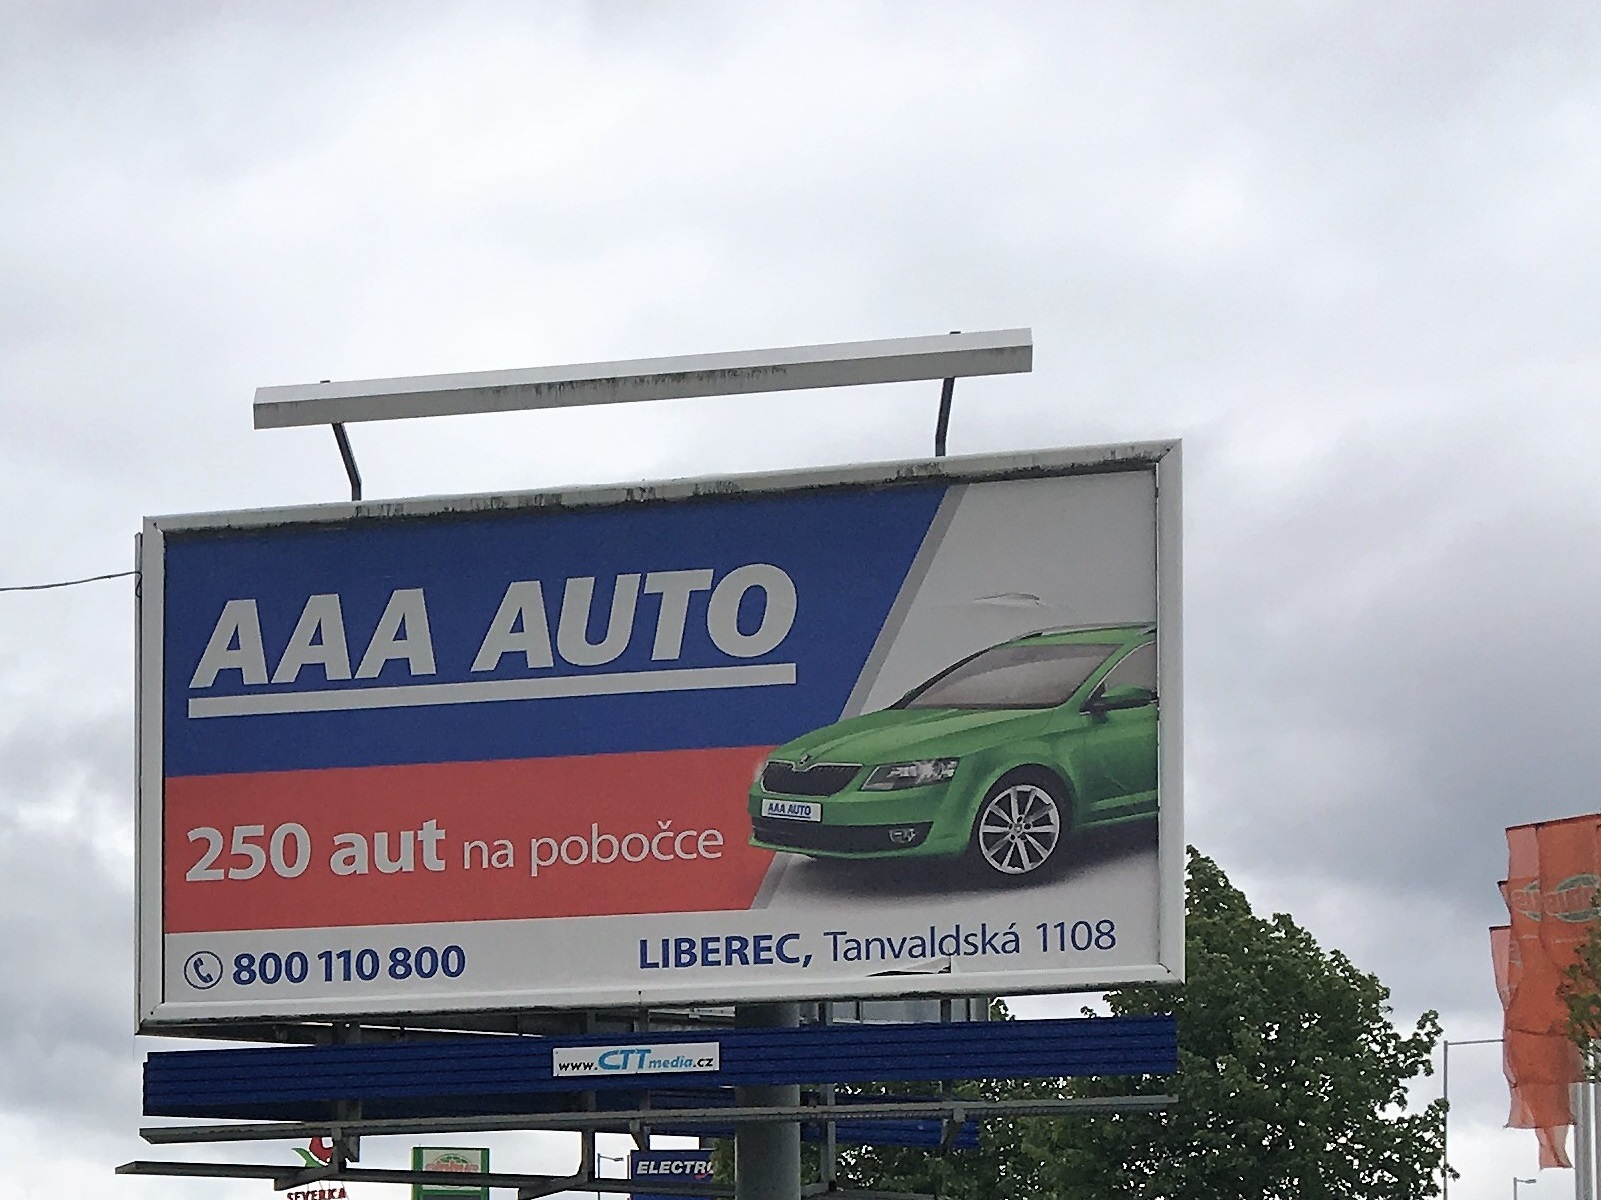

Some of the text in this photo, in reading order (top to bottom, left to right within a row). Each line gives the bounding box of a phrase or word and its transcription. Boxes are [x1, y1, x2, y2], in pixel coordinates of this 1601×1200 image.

[189, 563, 797, 688] AAA AUTO
[768, 802, 811, 816] AAA AUTO
[186, 817, 724, 882] 250 aut na pobočce
[232, 944, 466, 986] 800 110 800
[639, 919, 1117, 971] LIBEREC, Tanvaldská 1108
